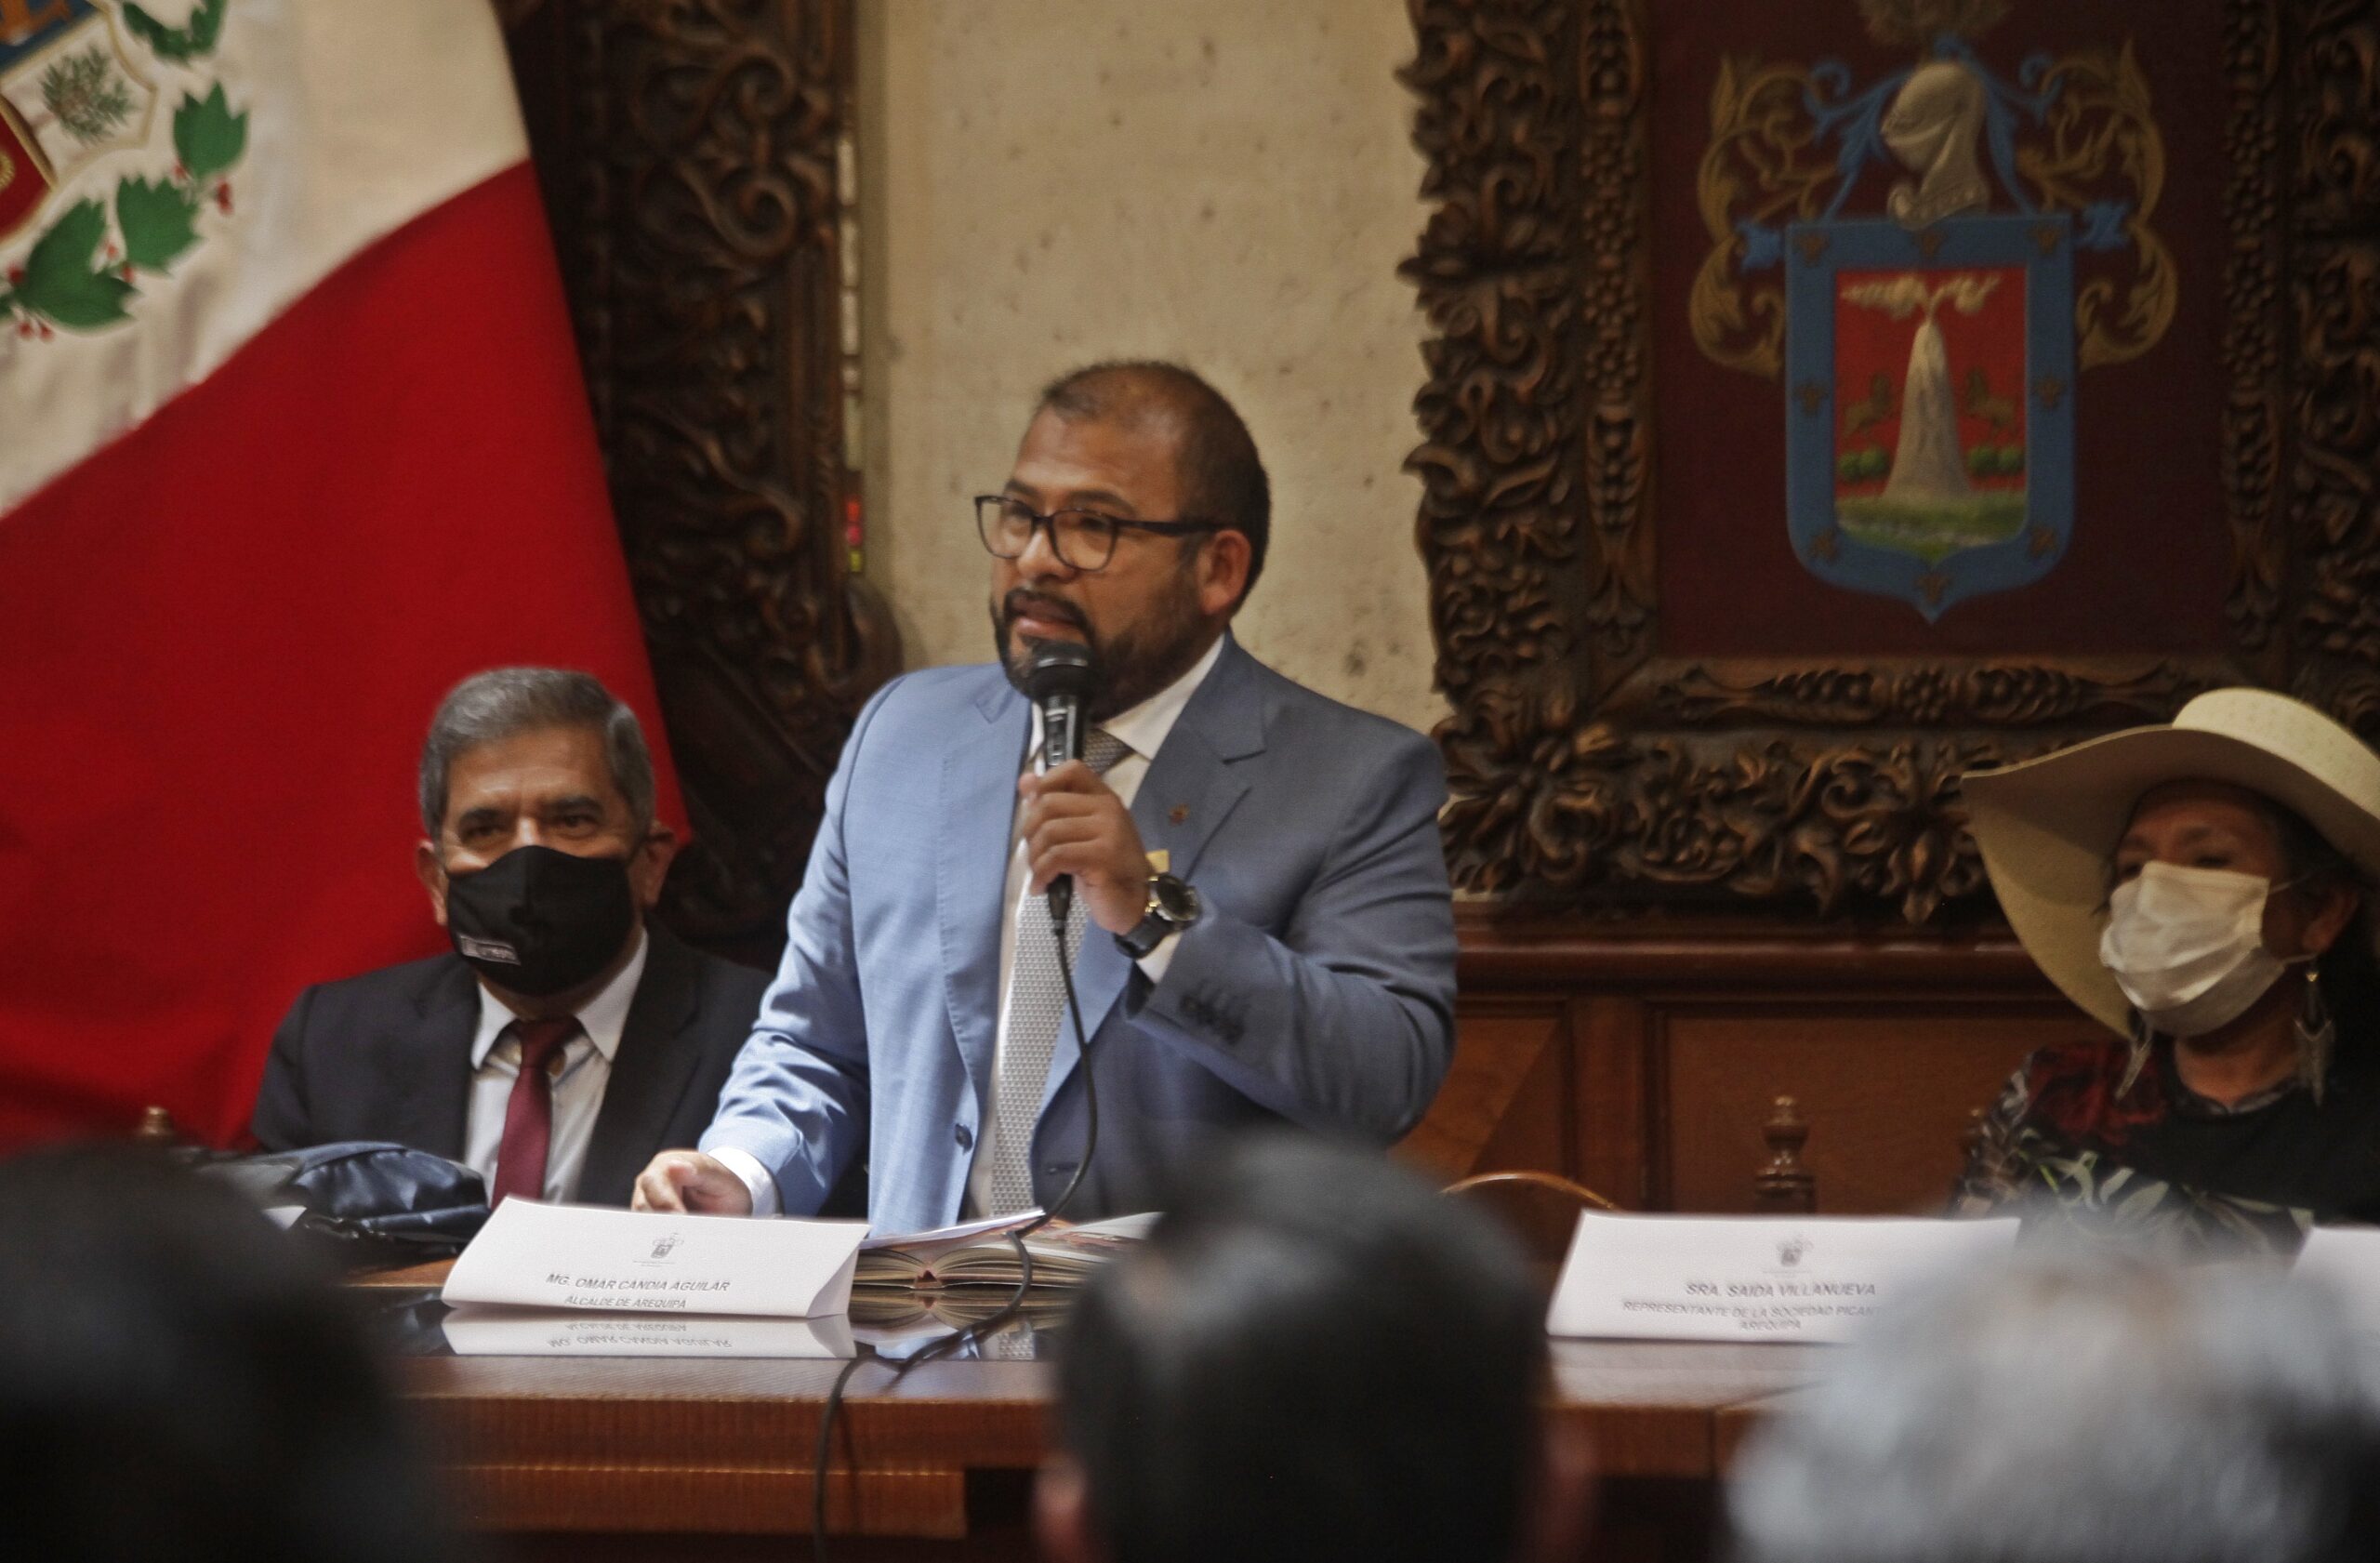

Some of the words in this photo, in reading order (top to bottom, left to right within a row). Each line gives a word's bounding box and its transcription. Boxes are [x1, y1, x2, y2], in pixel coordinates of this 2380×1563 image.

[546, 1273, 570, 1286] MG.
[575, 1278, 616, 1290] OMAR
[618, 1279, 668, 1291] CANDIA
[668, 1281, 731, 1291] AGUILAR
[1726, 1283, 1774, 1297] SAIDA
[1778, 1282, 1876, 1296] VILLANUEVA
[564, 1295, 614, 1306] ALCALDE
[615, 1298, 630, 1307] DE
[632, 1298, 687, 1308] AREQUIPA
[1622, 1300, 1730, 1317] REPRESENTANTE
